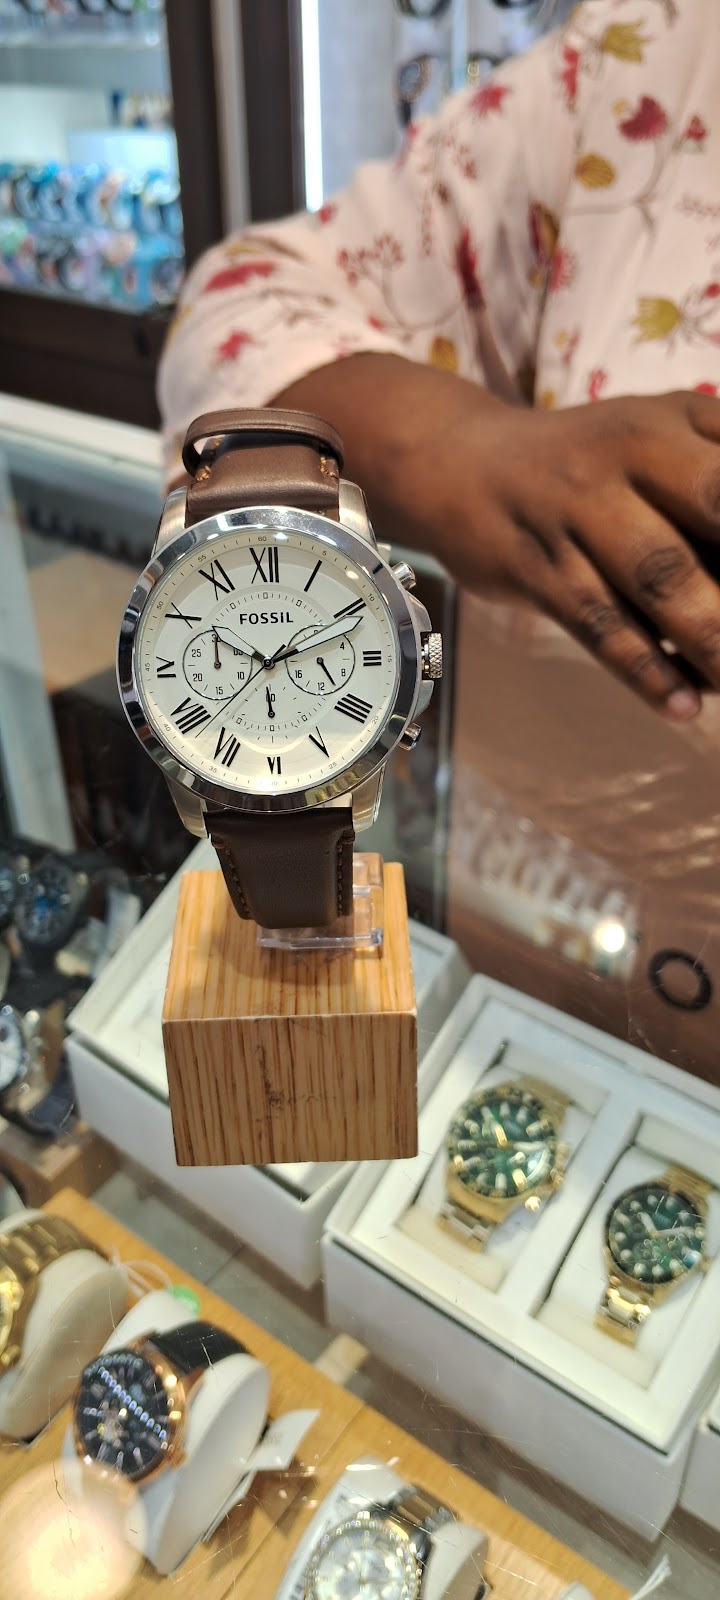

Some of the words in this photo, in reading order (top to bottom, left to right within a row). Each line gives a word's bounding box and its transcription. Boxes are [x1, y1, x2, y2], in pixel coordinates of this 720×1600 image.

[249, 547, 280, 584] XII
[198, 559, 236, 601] XI
[164, 602, 202, 629] X
[239, 611, 294, 625] FOSSIL
[339, 641, 345, 650] 4
[191, 649, 202, 658] 25
[192, 673, 203, 682] 20
[236, 671, 245, 680] 10
[294, 669, 303, 679] 16
[340, 668, 346, 677] 8
[215, 686, 224, 695] 15
[317, 681, 325, 691] 12
[169, 696, 212, 735] VIII
[213, 726, 241, 768] VII
[308, 726, 330, 758] V
[266, 756, 282, 775] VI
